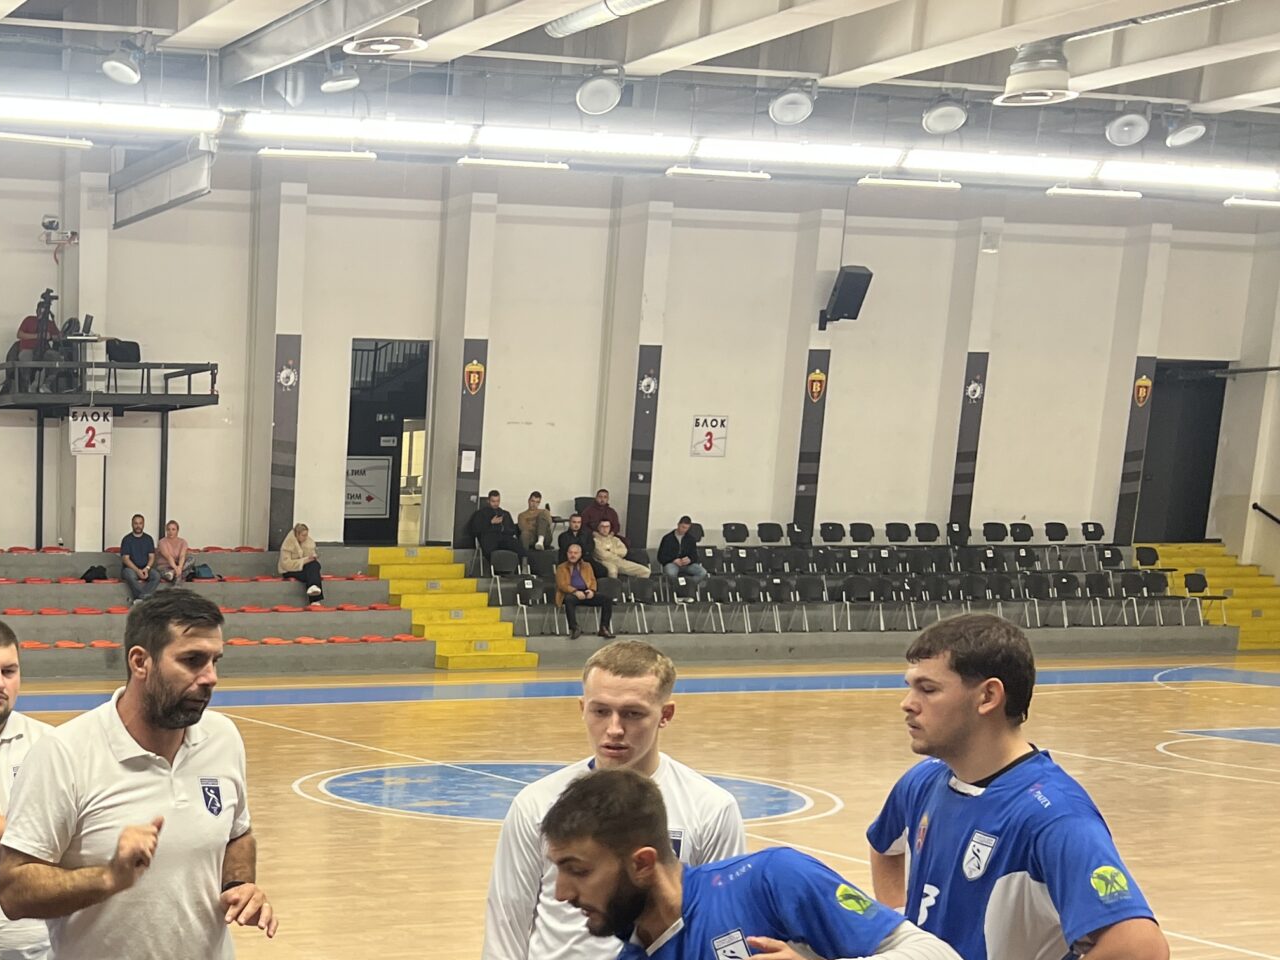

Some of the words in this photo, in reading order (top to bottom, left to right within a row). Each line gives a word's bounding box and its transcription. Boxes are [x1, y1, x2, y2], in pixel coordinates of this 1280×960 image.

[71, 411, 110, 422] БЛОК
[694, 418, 727, 428] БЛОК
[84, 425, 96, 448] 2
[703, 431, 714, 451] 3
